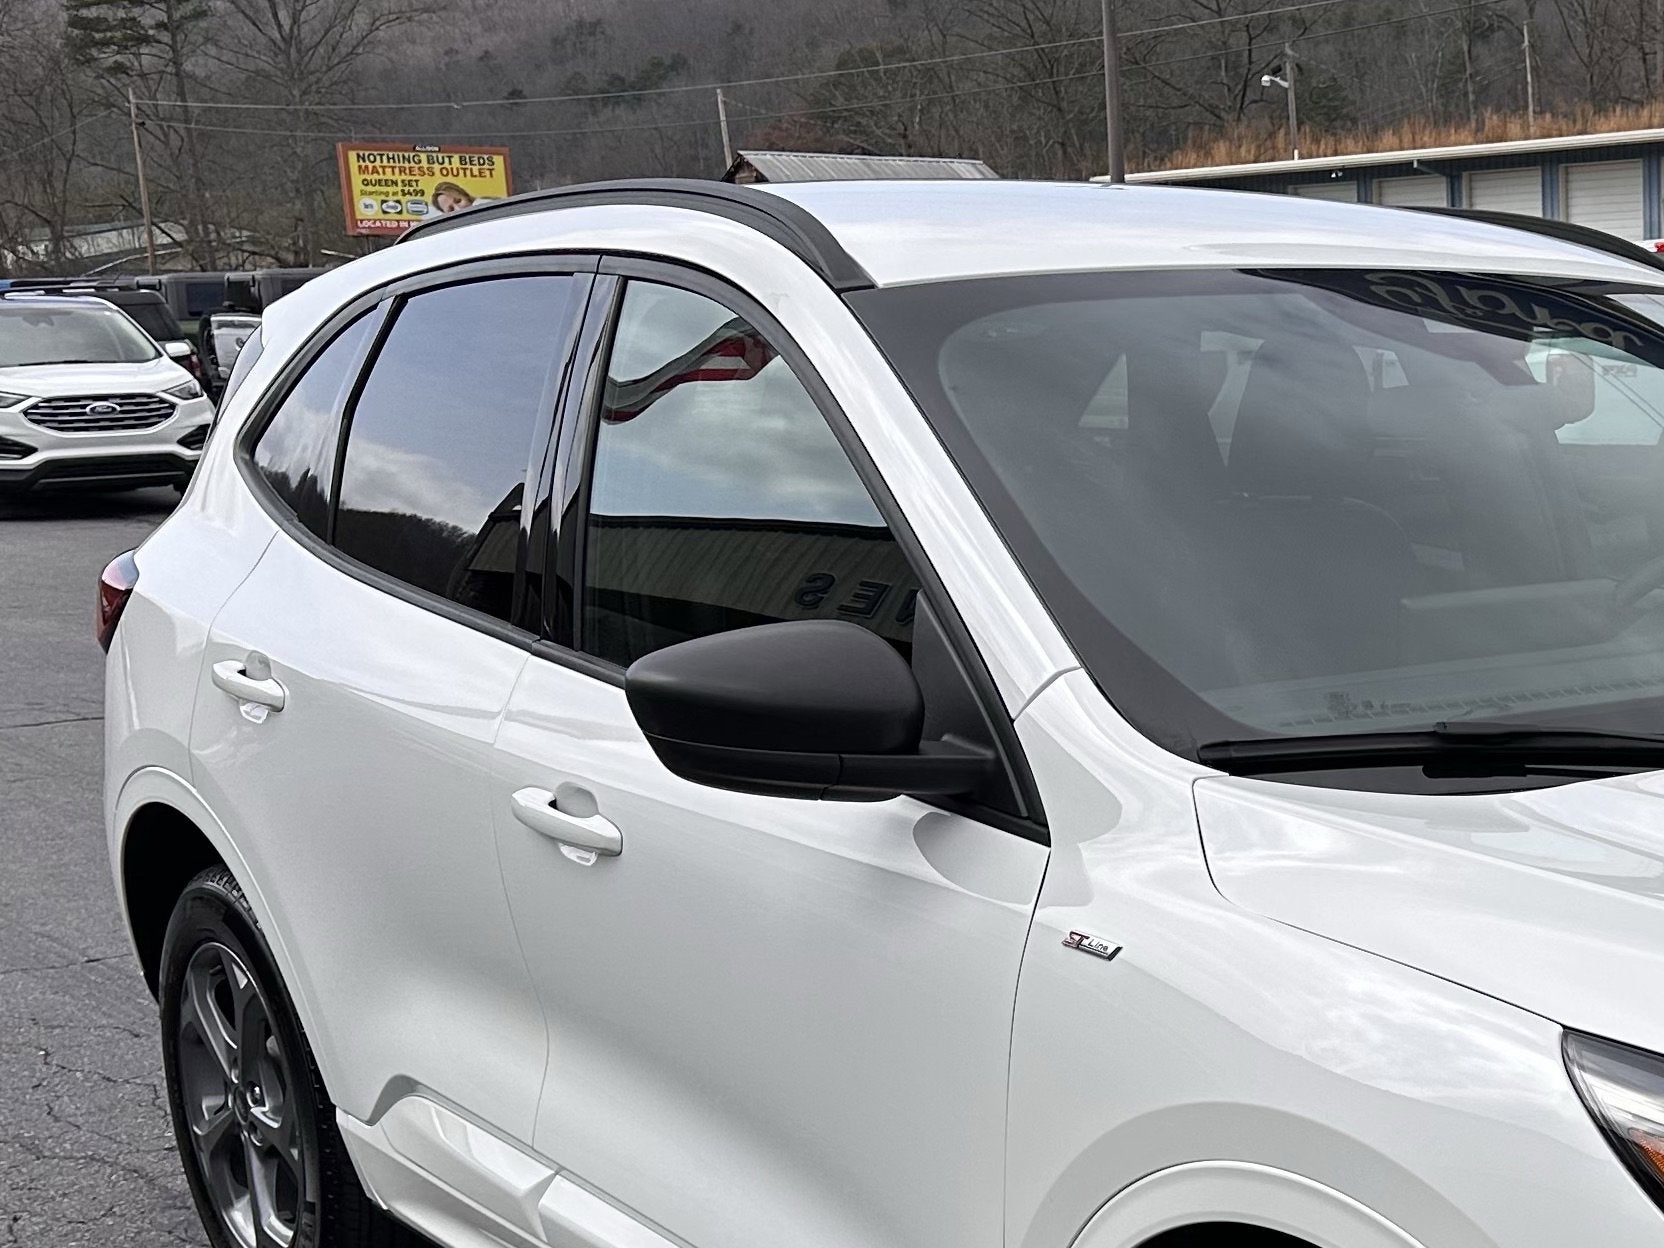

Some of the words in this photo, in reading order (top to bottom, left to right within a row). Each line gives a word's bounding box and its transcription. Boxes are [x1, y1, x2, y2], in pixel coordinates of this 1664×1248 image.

[356, 152, 422, 165] NOTHING
[426, 154, 454, 165] BUT
[459, 155, 495, 166] BEDS
[357, 164, 435, 177] MATTRESS
[440, 166, 495, 178] OUTLET
[361, 178, 398, 188] QUEEN
[401, 179, 420, 188] SET
[360, 189, 390, 197] Starting
[400, 188, 425, 197] $499
[357, 220, 398, 228] LOCATED
